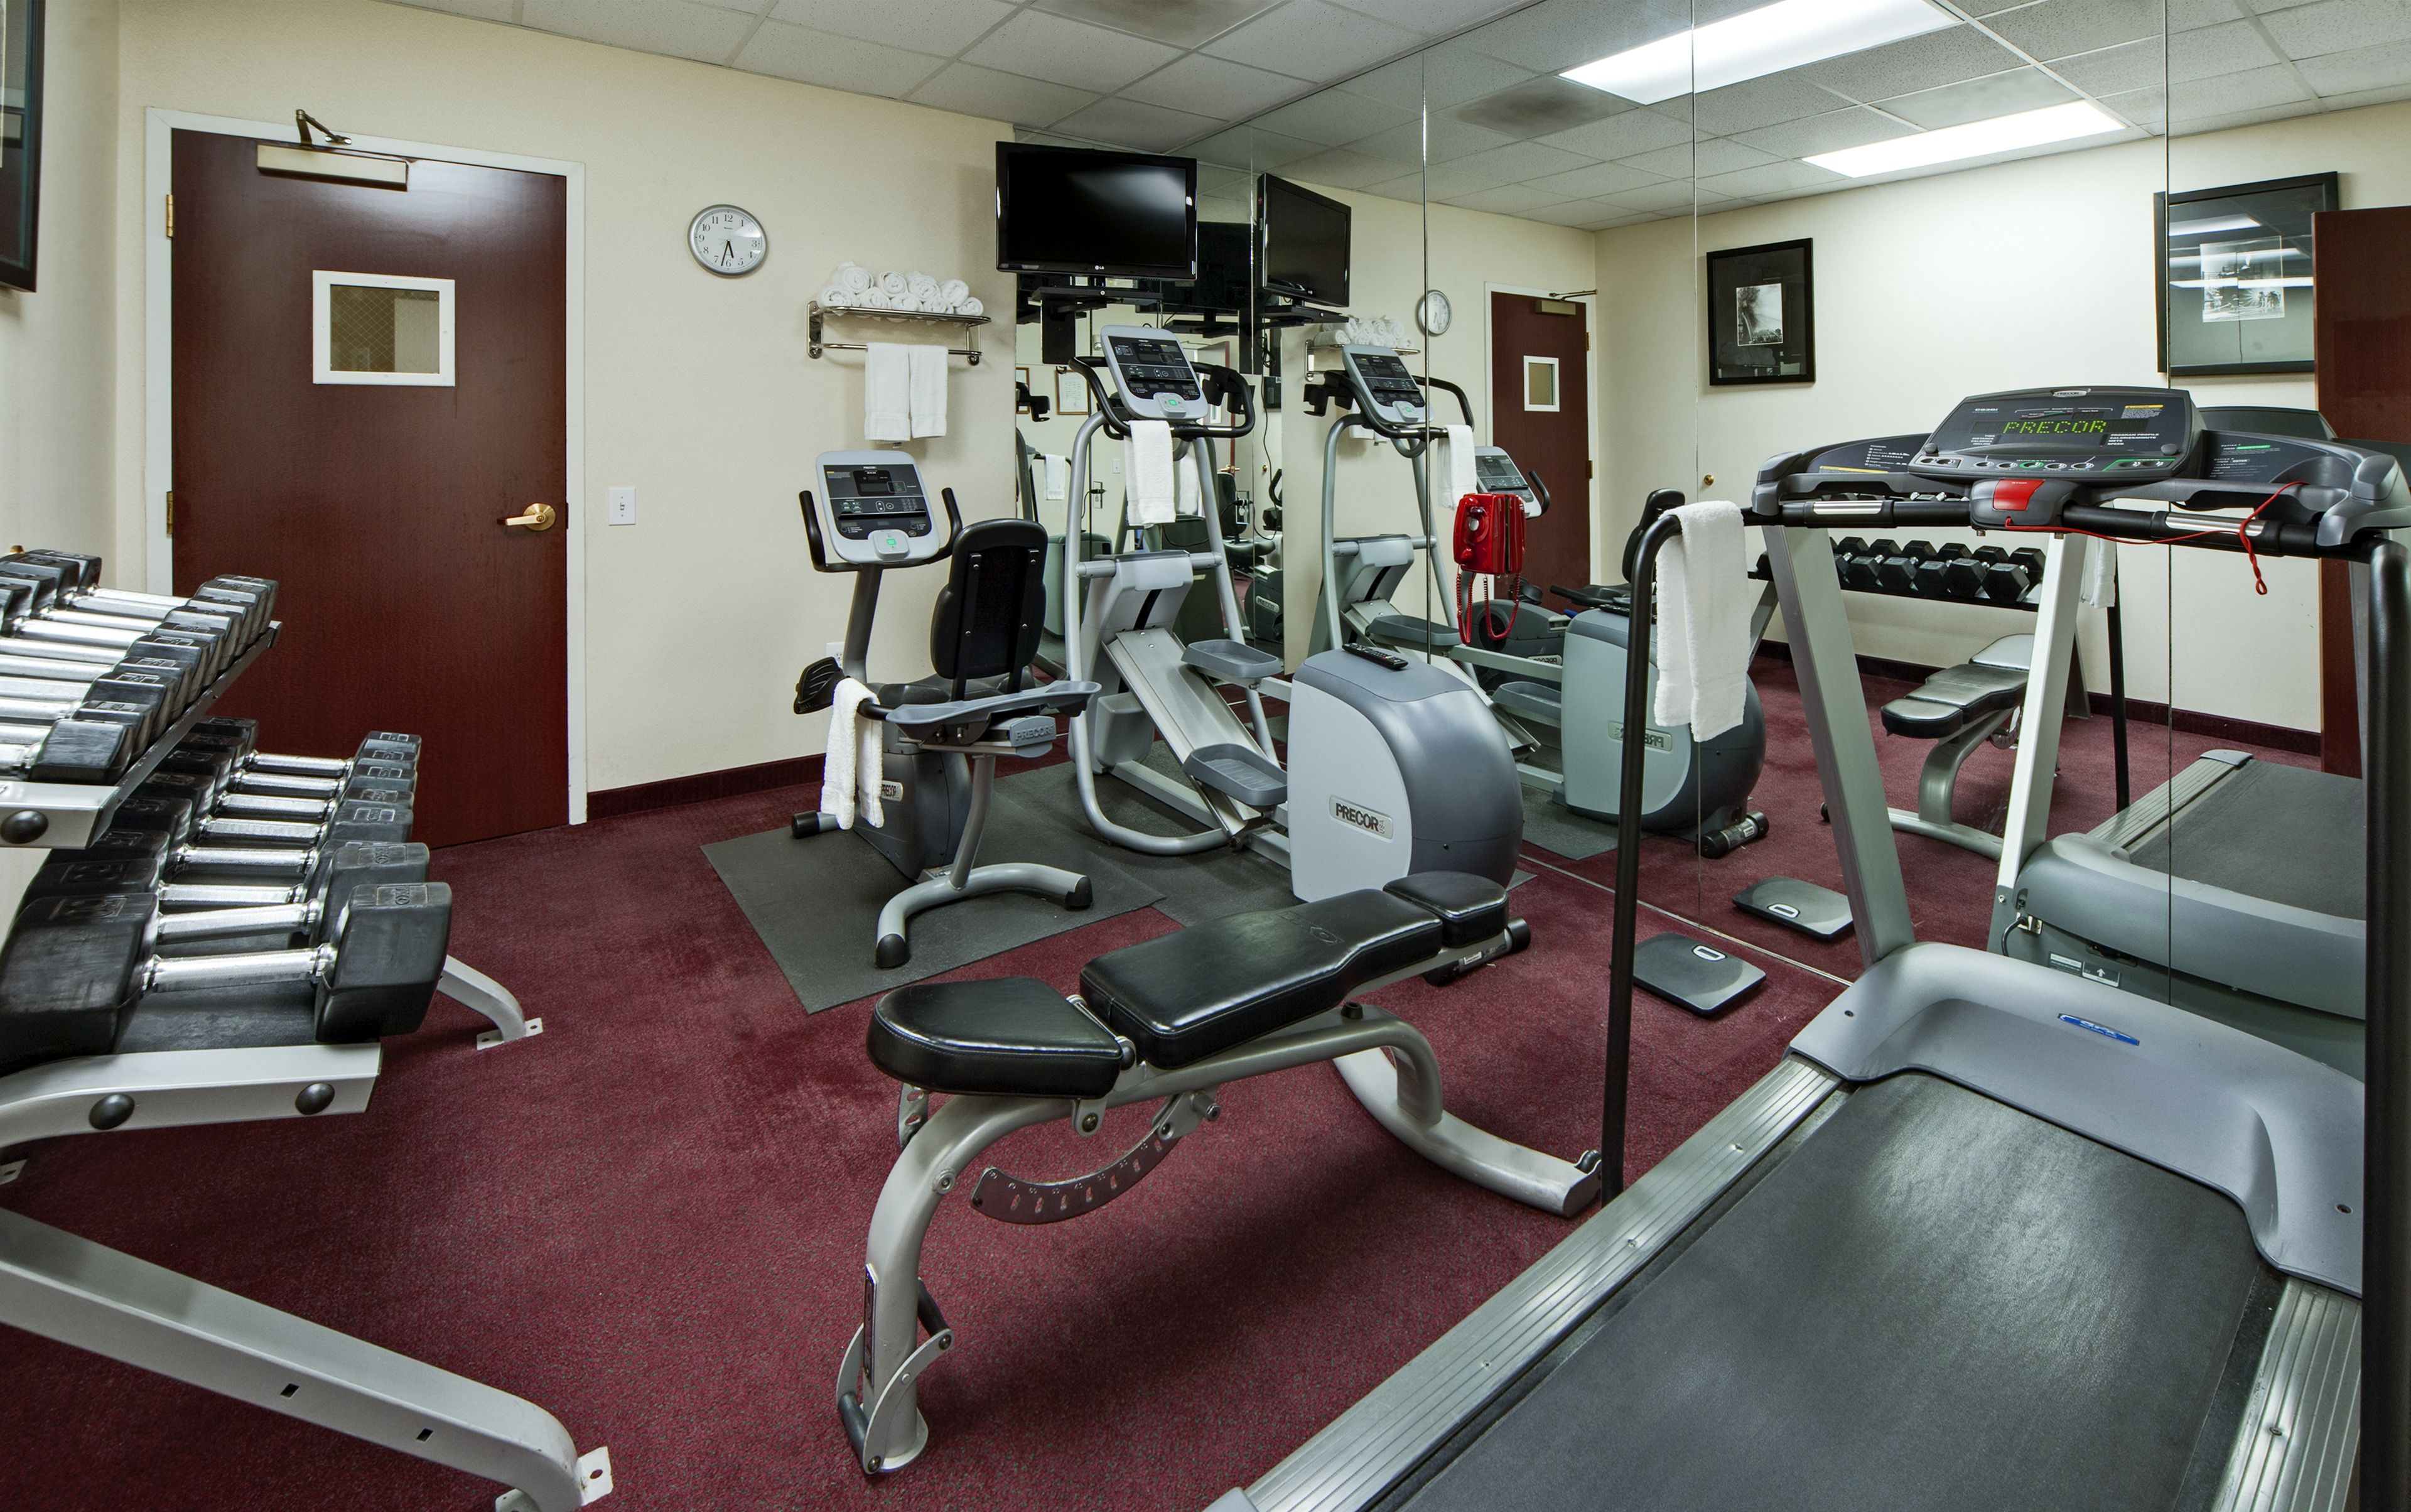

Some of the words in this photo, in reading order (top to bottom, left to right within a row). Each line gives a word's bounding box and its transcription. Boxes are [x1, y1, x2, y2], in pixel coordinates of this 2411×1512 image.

[712, 216, 718, 224] 11
[724, 214, 733, 222] 12
[703, 224, 711, 232] 10
[699, 234, 705, 242] 9
[703, 246, 709, 254] 8
[714, 255, 719, 263] 7
[738, 257, 743, 266] 5
[2002, 421, 2108, 434] PRECOR
[1335, 802, 1379, 832] PRECOR
